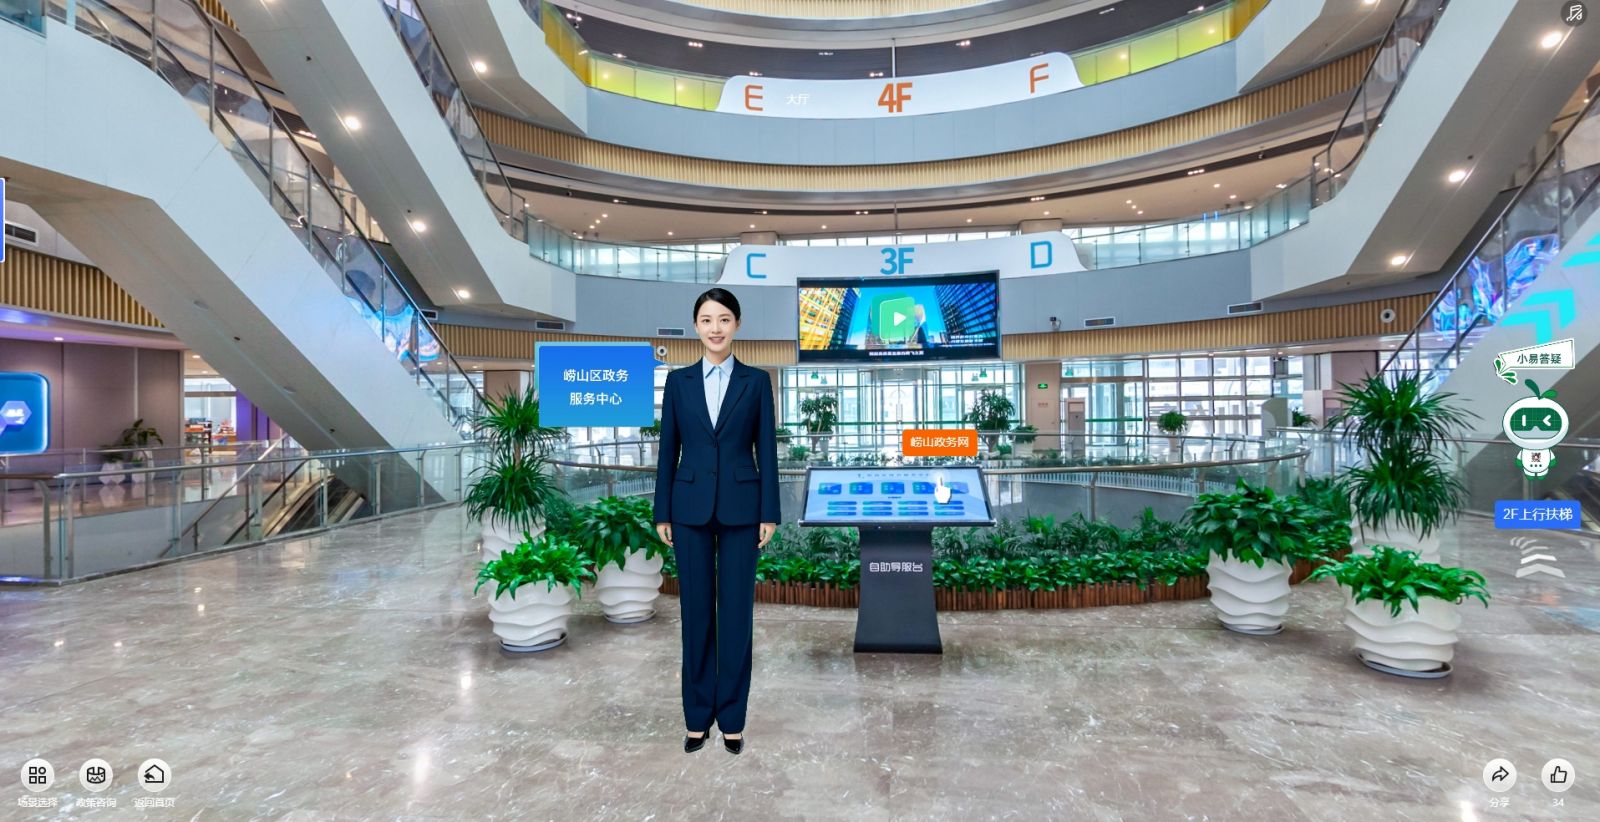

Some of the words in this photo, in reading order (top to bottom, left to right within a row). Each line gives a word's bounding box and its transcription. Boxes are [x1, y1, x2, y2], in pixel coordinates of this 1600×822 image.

[744, 84, 763, 111] E
[877, 82, 913, 113] 4F
[1029, 62, 1049, 94] F
[746, 253, 767, 279] C
[880, 247, 915, 275] 3F
[1030, 240, 1053, 269] D
[869, 561, 924, 573] 自助导服台
